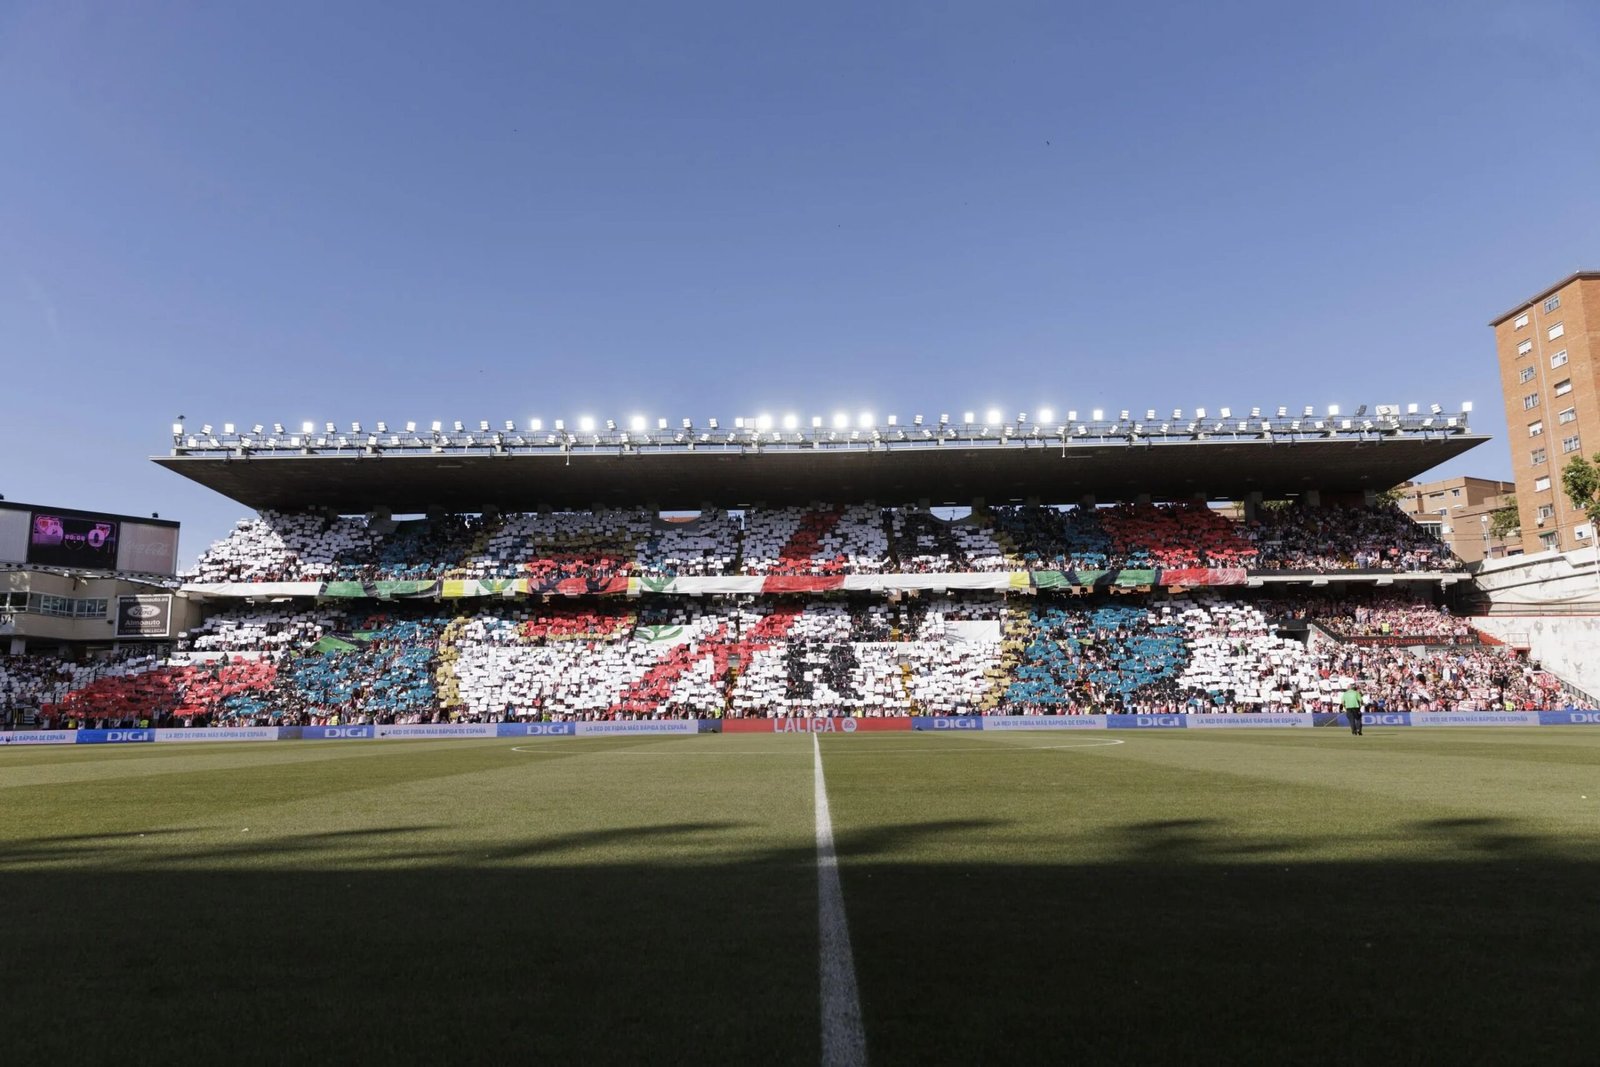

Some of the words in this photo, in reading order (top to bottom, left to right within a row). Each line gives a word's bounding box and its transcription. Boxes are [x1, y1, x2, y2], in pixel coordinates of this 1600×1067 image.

[934, 719, 976, 728] DIGI
[1137, 717, 1179, 726] DIGI
[1361, 715, 1404, 724] DIGI
[774, 717, 835, 732] LALIGA
[325, 728, 367, 738] DIGI
[527, 725, 568, 734] DIGI
[106, 731, 148, 741] DIGI
